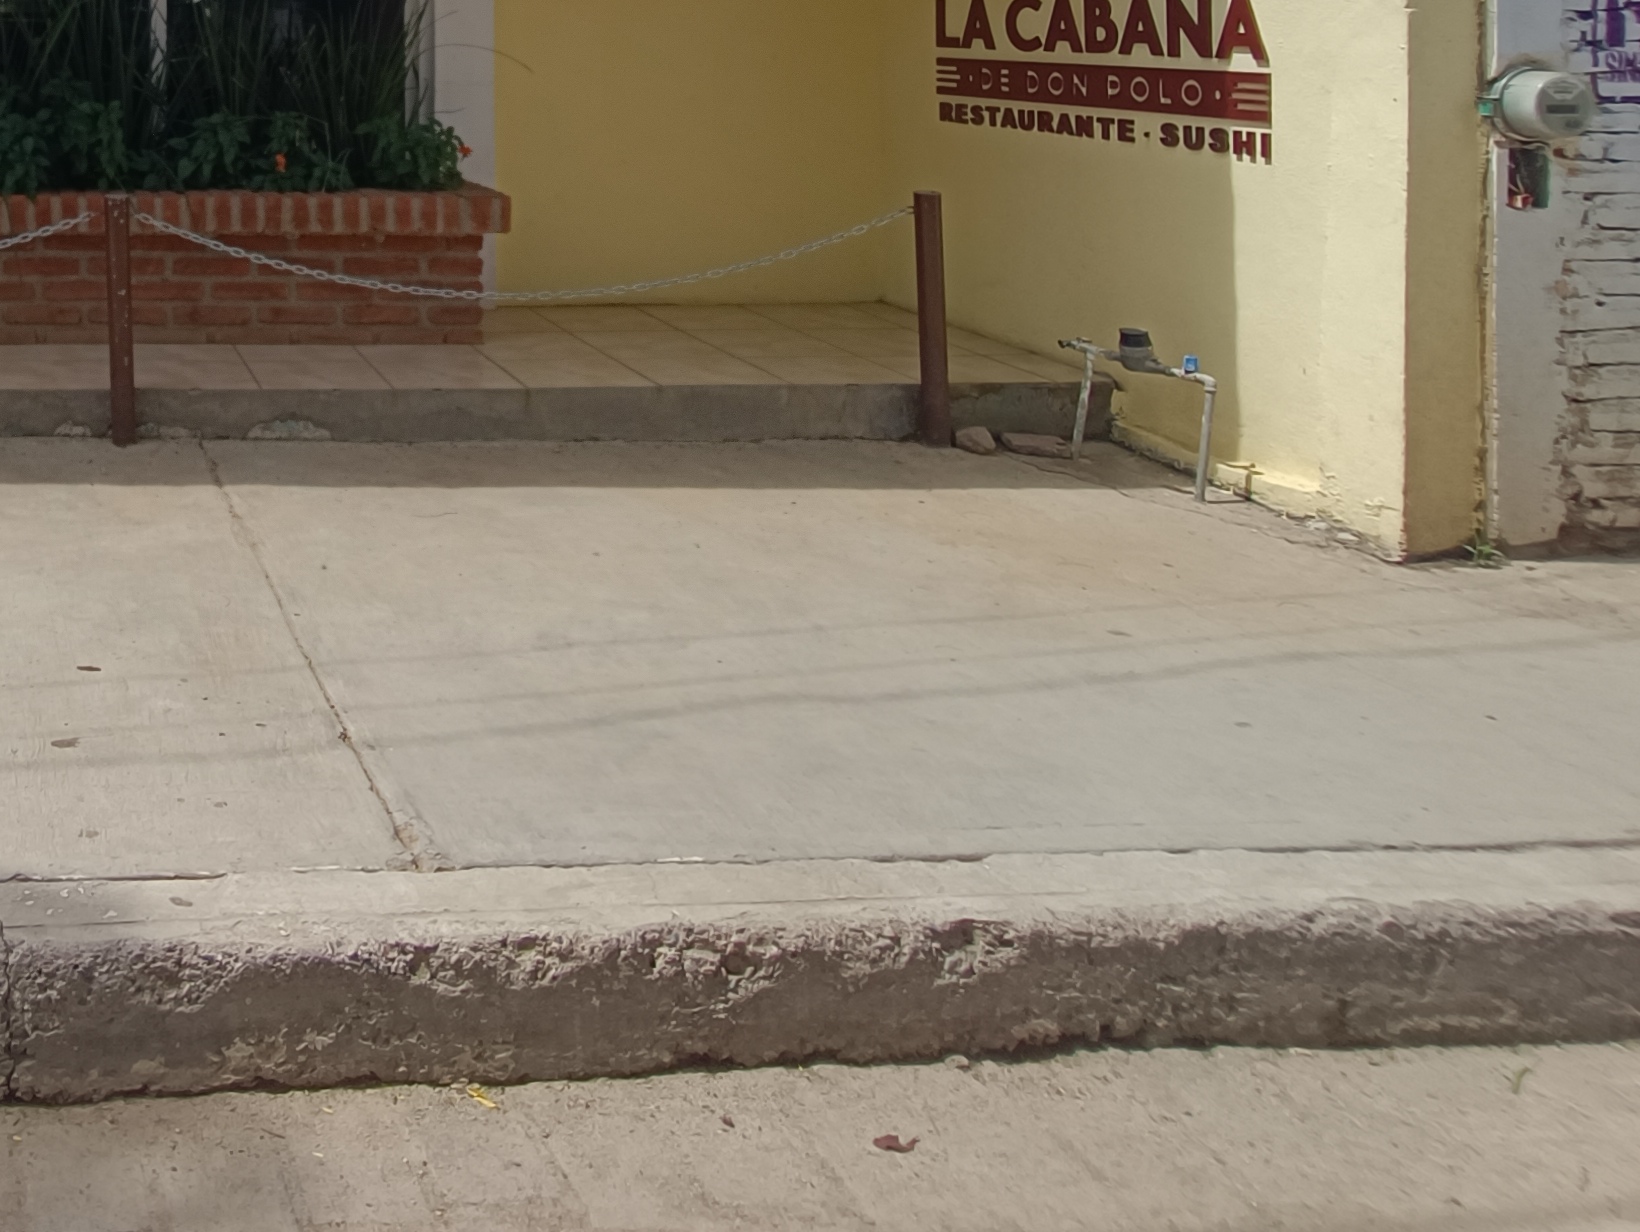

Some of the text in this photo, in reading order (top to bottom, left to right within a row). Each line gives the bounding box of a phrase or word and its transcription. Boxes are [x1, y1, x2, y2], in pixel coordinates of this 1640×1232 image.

[981, 68, 1203, 107] DE DON POLO
[938, 101, 1272, 165] RESTAURANTE SUSHI
